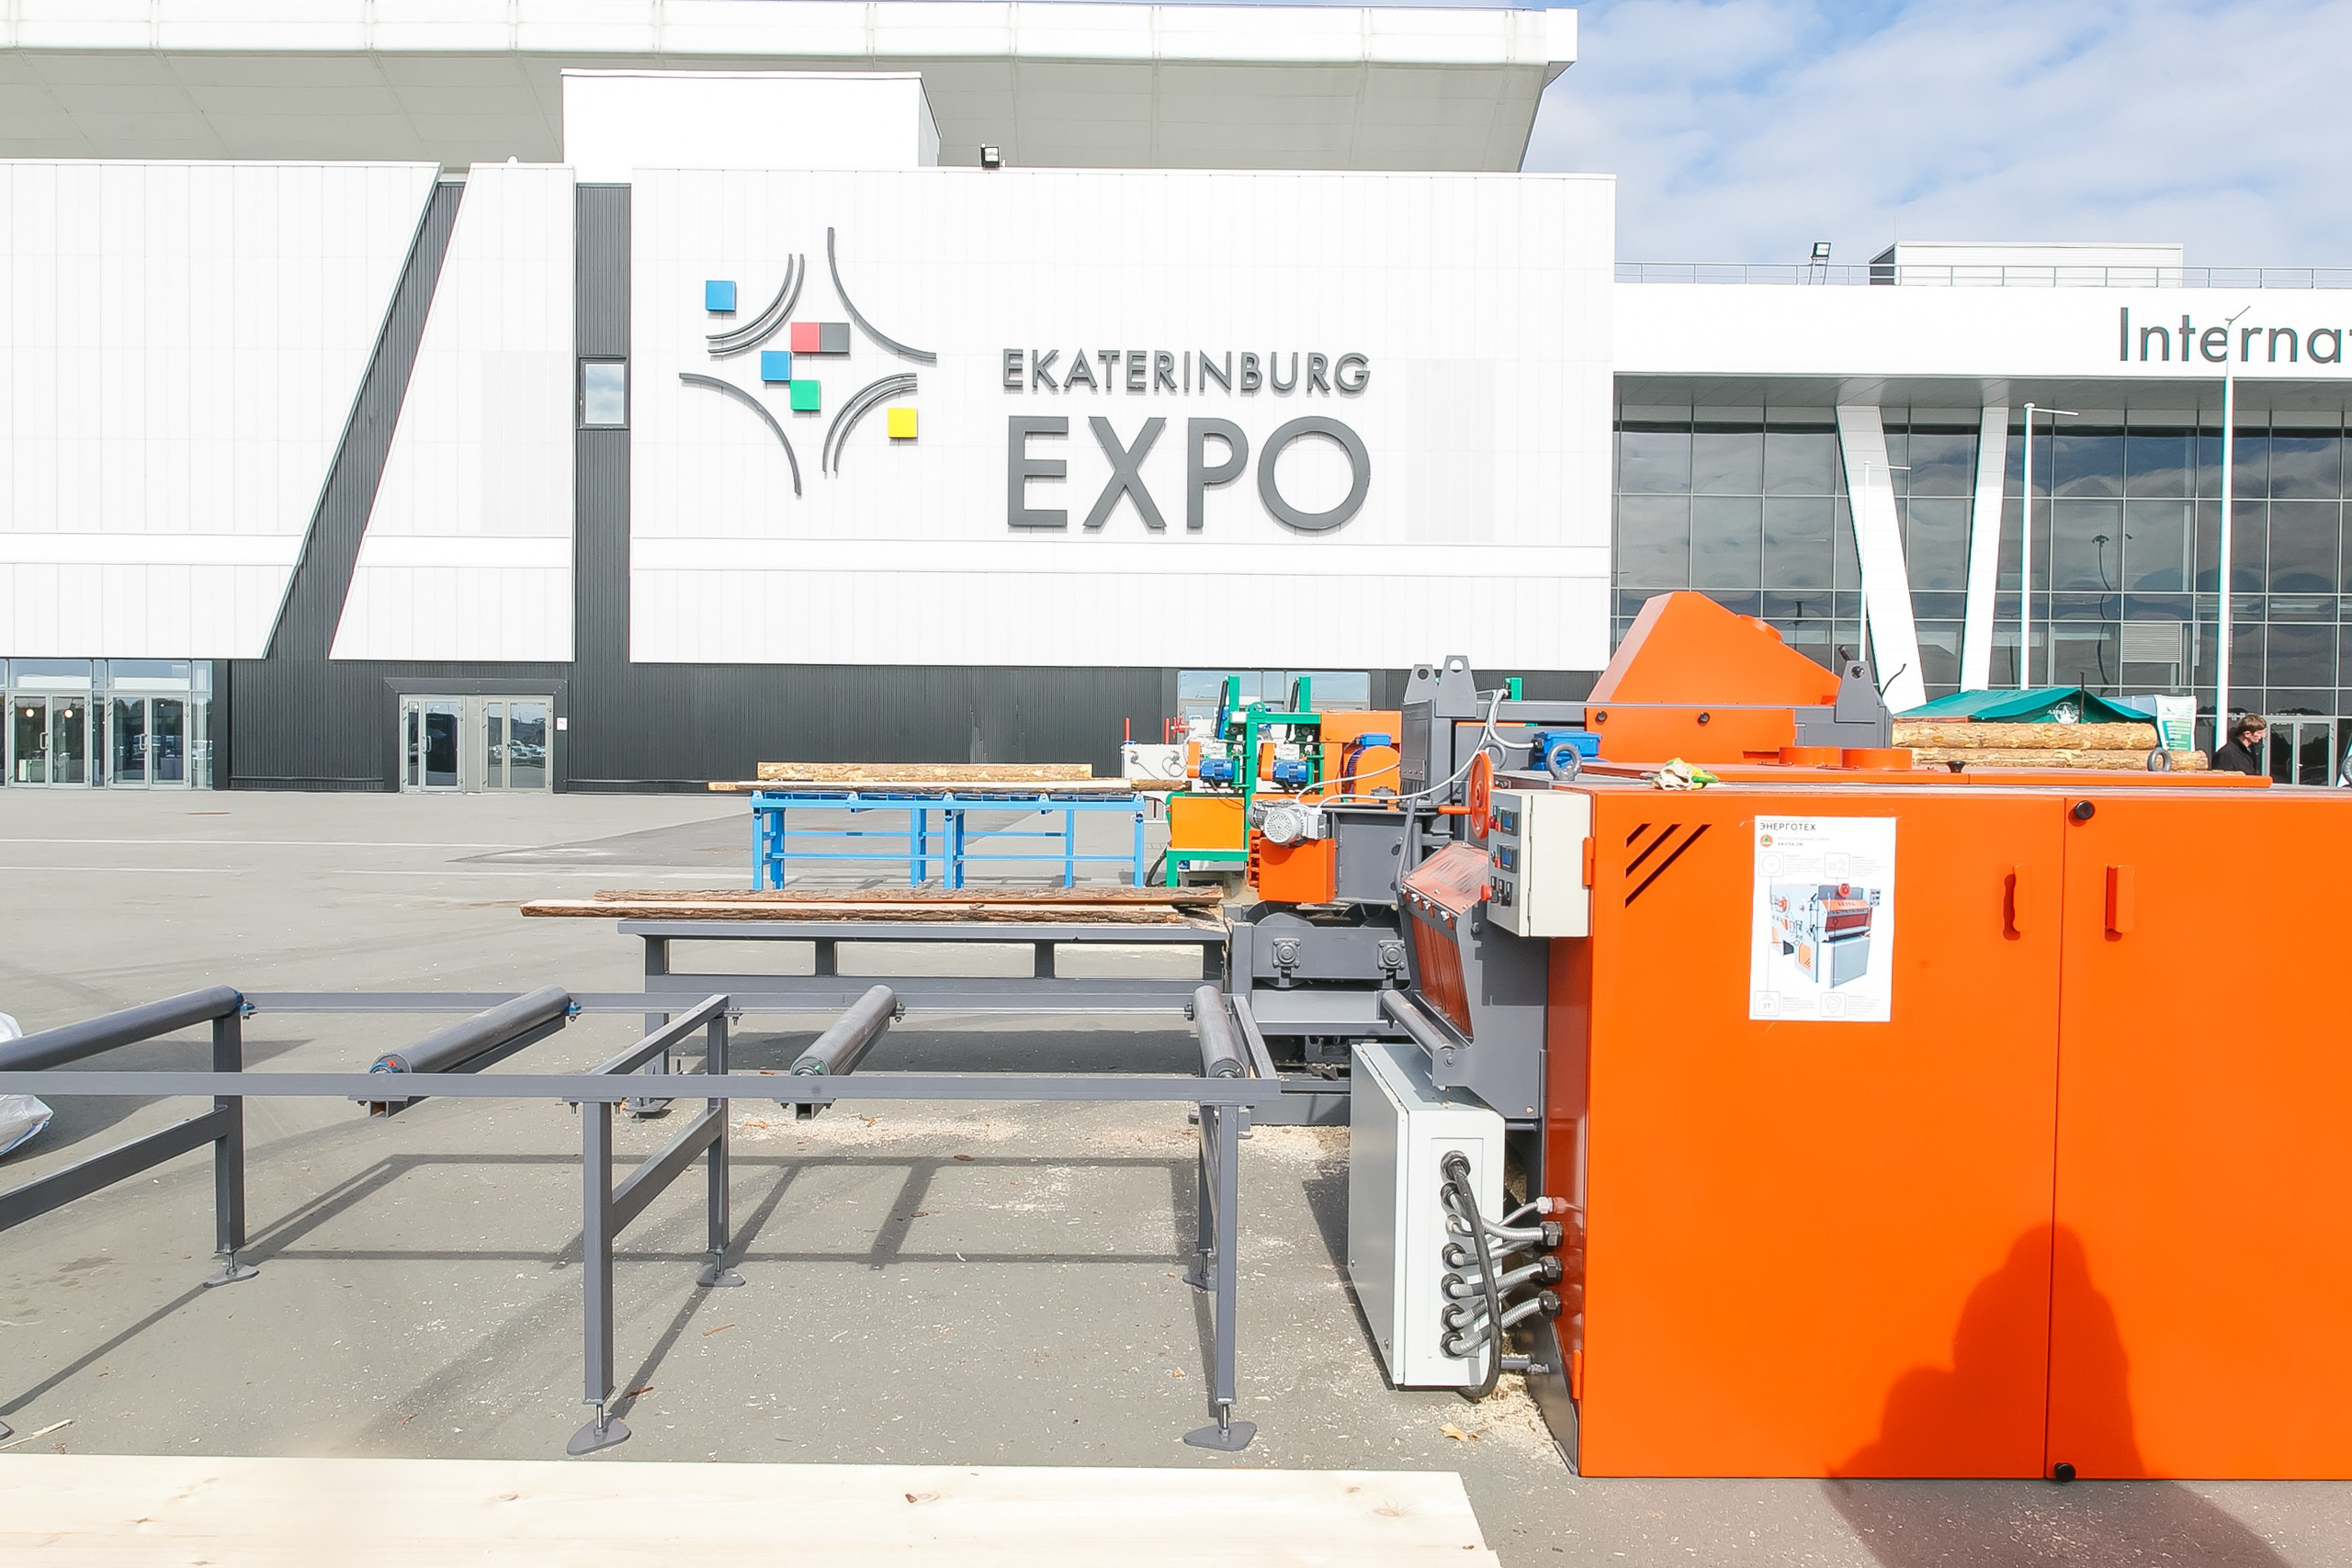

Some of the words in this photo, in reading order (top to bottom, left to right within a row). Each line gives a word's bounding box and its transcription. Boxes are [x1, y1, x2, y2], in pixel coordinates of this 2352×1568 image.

[2120, 307, 2352, 364] Interna
[1002, 348, 1371, 392] EKATERINBURG
[1007, 415, 1371, 531] EXPO
[1759, 822, 1816, 831] ЭНЕРГОТЕХ
